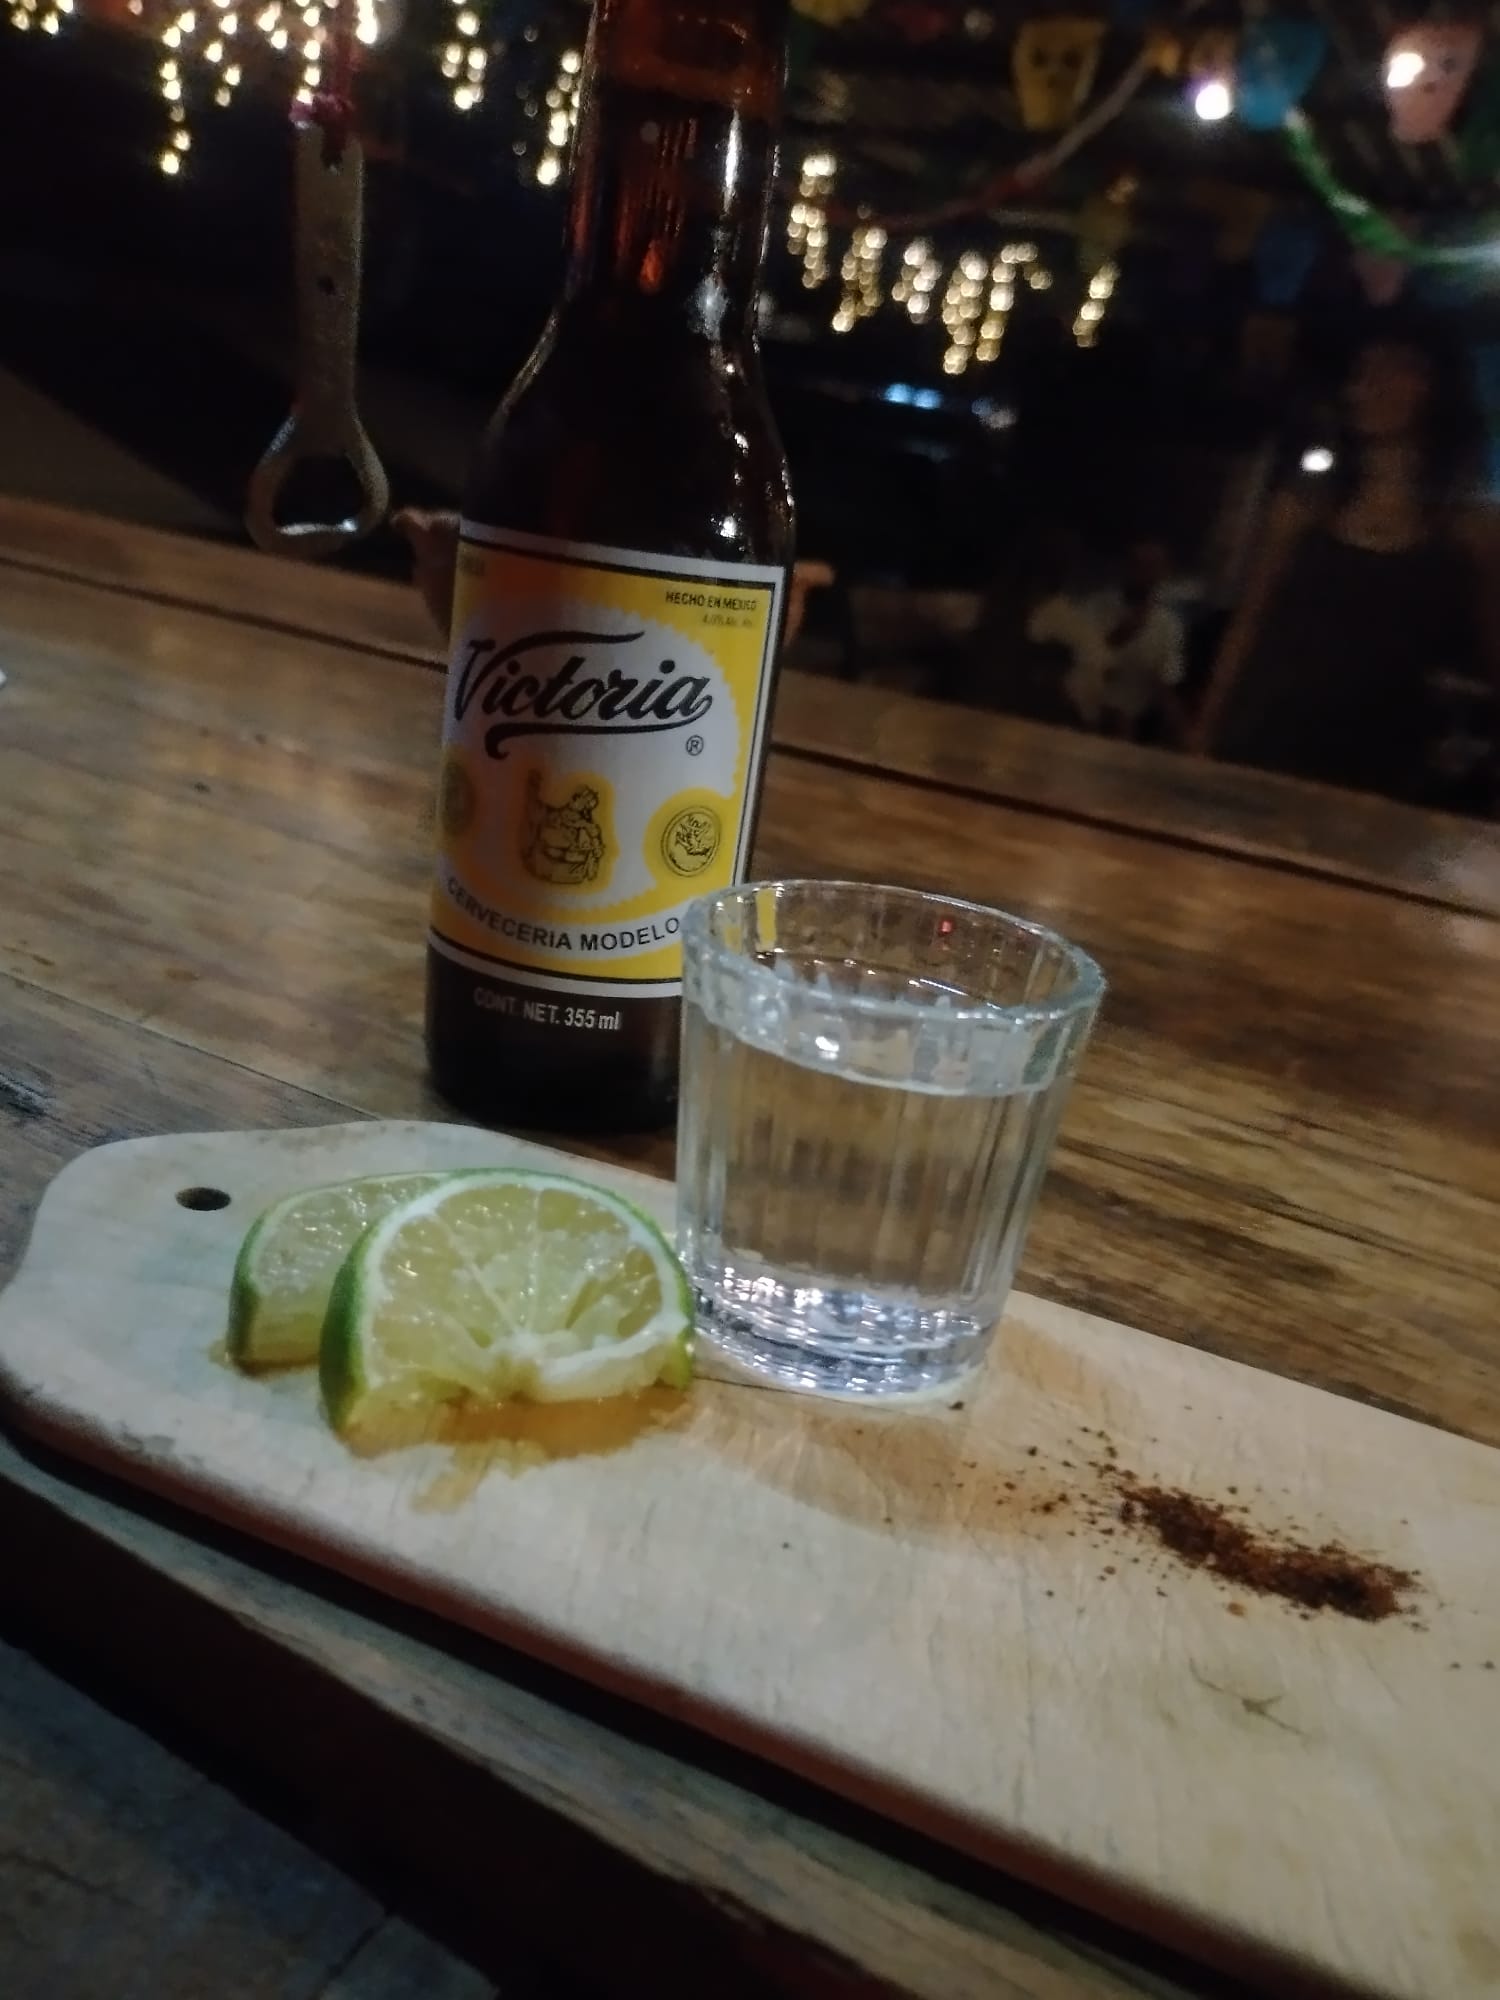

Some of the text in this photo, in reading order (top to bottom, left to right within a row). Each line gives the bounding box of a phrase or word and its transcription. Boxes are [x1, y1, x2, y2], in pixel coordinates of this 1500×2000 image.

[665, 591, 705, 607] HECHO
[707, 595, 721, 609] EN
[453, 630, 713, 757] Victoria
[446, 877, 680, 951] CERVECERIA MODELO
[523, 1000, 561, 1025] NET.
[564, 1006, 597, 1029] 355
[598, 1010, 621, 1031] ml
